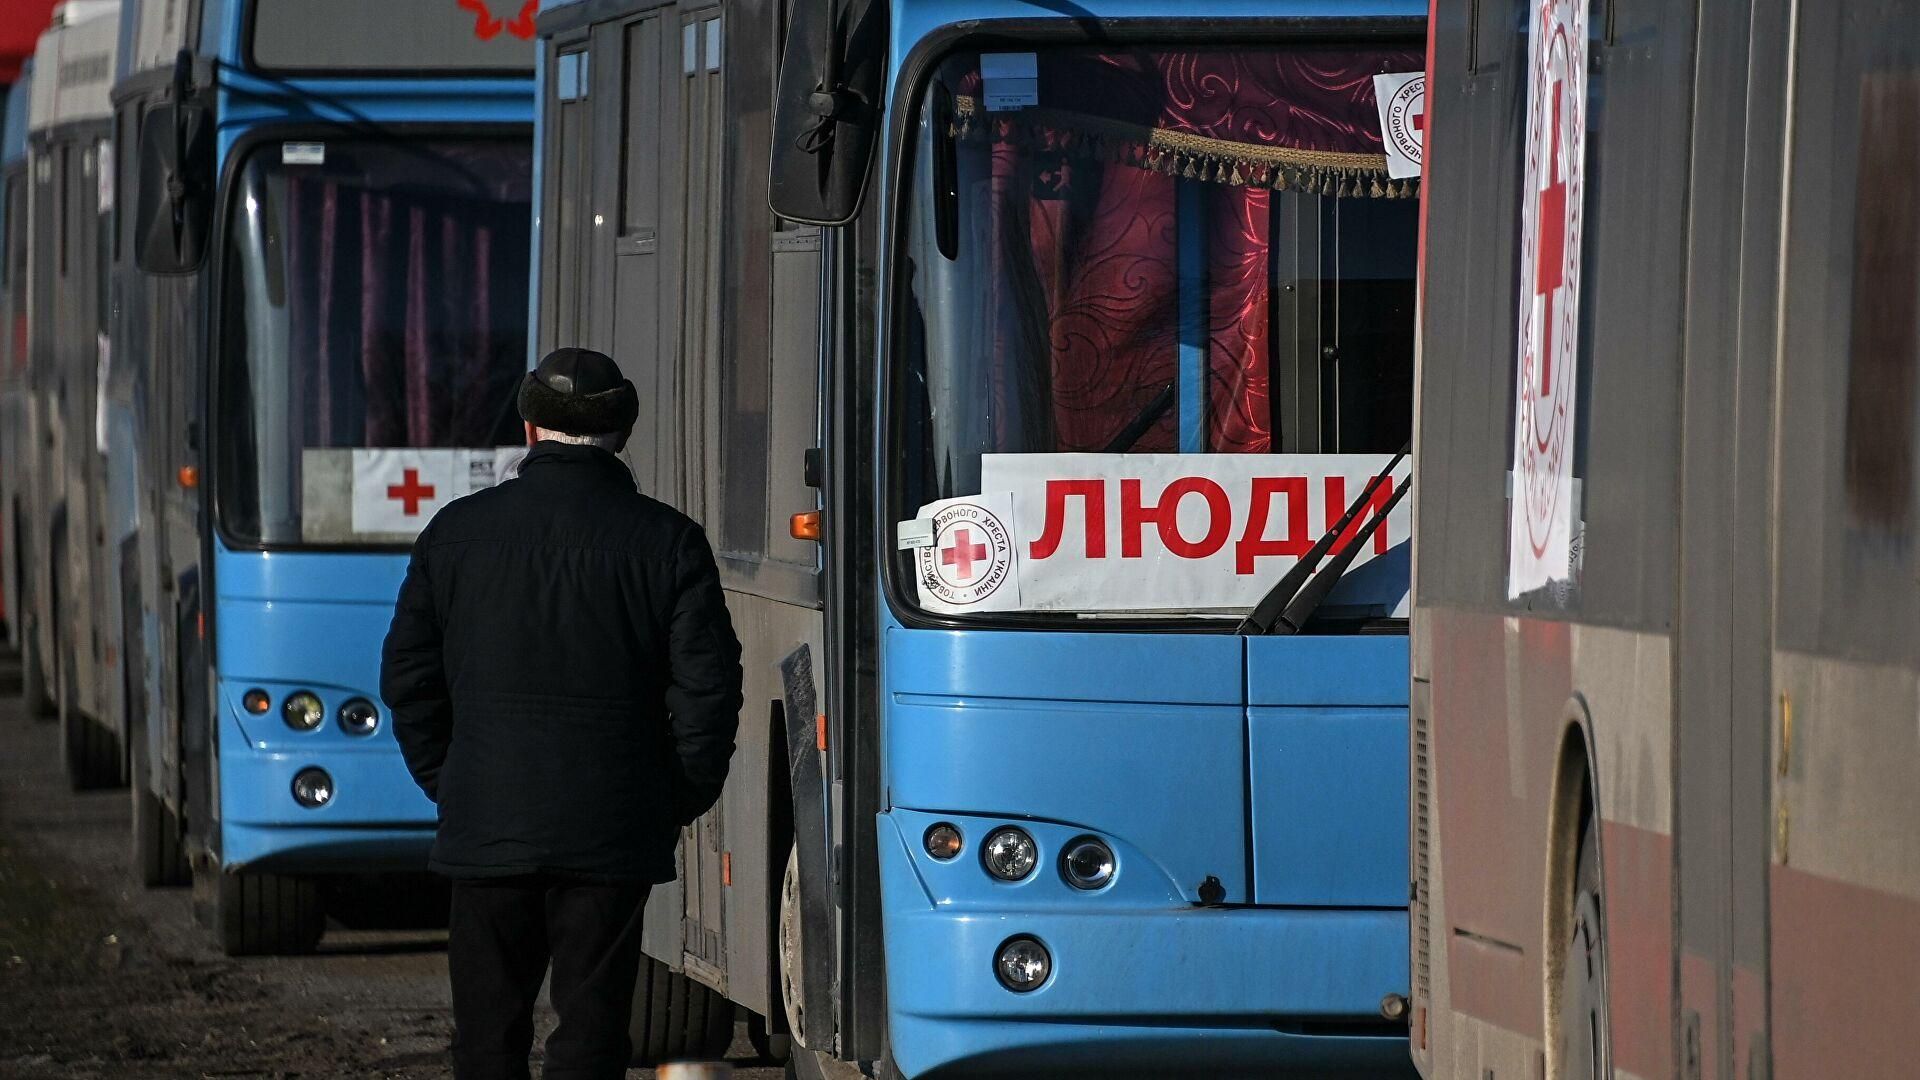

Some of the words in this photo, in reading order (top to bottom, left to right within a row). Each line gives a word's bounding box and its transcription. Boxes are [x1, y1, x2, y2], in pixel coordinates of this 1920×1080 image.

[1399, 81, 1425, 102] ХРЕСТ
[1393, 106, 1421, 159] ЧЕРВОНОГО
[982, 516, 1006, 553] ХРЕСТА
[1029, 475, 1393, 575] ЛЮДИ
[974, 559, 1006, 597] УКРАЇНИ
